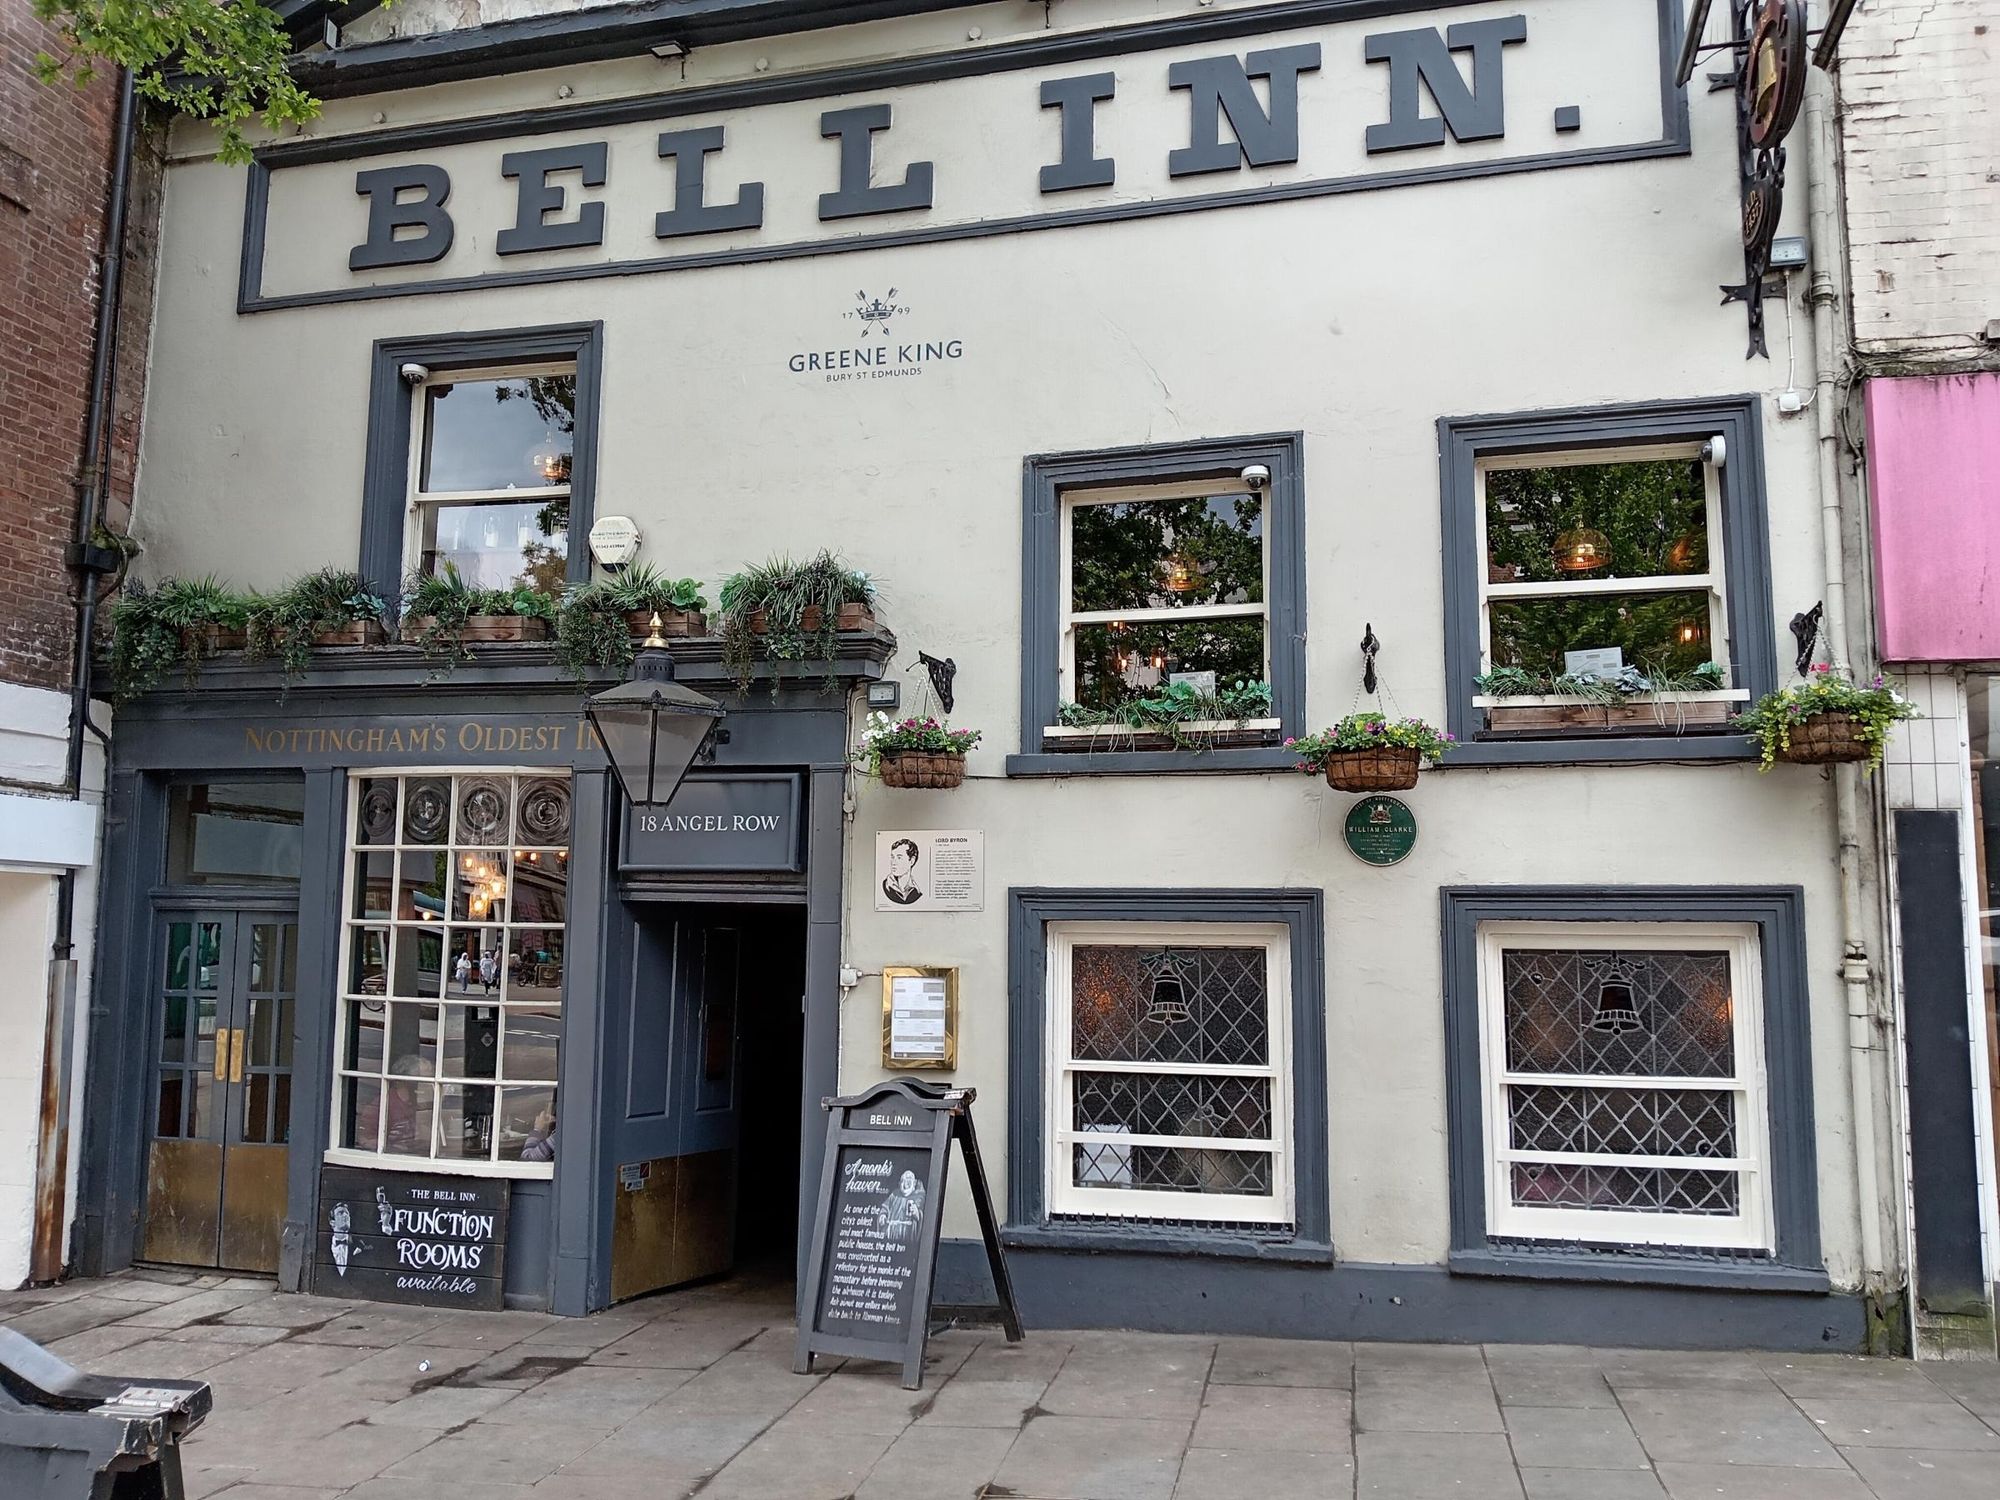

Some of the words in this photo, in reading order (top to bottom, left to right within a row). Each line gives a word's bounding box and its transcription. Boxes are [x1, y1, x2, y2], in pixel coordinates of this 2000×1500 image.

[349, 103, 933, 271] BELL
[1040, 15, 1580, 192] INN.
[842, 312, 853, 320] 17
[897, 306, 911, 315] 99
[788, 347, 887, 372] GREENE
[899, 340, 963, 363] KING
[826, 373, 852, 382] BURY
[856, 371, 867, 380] ST
[871, 367, 922, 379] EDMUNDS
[244, 722, 447, 753] NOTTINGHAM'S
[458, 722, 566, 752] OLDEST
[640, 815, 657, 832] 18
[660, 815, 728, 832] ANGEL
[732, 815, 780, 832] ROW
[870, 1114, 891, 1125] BELL
[893, 1115, 912, 1126] INN
[859, 1160, 893, 1177] monk's
[411, 1189, 430, 1200] THE
[434, 1190, 456, 1201] BELL
[459, 1192, 476, 1202] INN
[843, 1203, 851, 1214] As
[863, 1205, 871, 1214] of
[871, 1205, 880, 1215] the
[393, 1207, 493, 1241] FUNCTION
[856, 1216, 873, 1226] oldest
[840, 1227, 851, 1237] and
[851, 1228, 864, 1238] most
[865, 1228, 885, 1239] famous
[838, 1238, 855, 1249] public
[876, 1241, 884, 1250] the
[885, 1242, 896, 1251] Bell
[897, 1243, 906, 1252] Inn
[397, 1238, 483, 1270] ROOMS
[837, 1252, 847, 1260] was
[848, 1252, 879, 1262] constructed
[835, 1262, 858, 1273] refectory
[859, 1263, 867, 1273] for
[868, 1264, 877, 1274] the
[877, 1265, 894, 1276] monks
[894, 1266, 901, 1276] of
[901, 1267, 911, 1277] the
[397, 1275, 477, 1294] available
[861, 1275, 878, 1286] before
[878, 1277, 903, 1290] becoming
[832, 1285, 841, 1295] the
[865, 1288, 871, 1297] it
[871, 1289, 877, 1298] is
